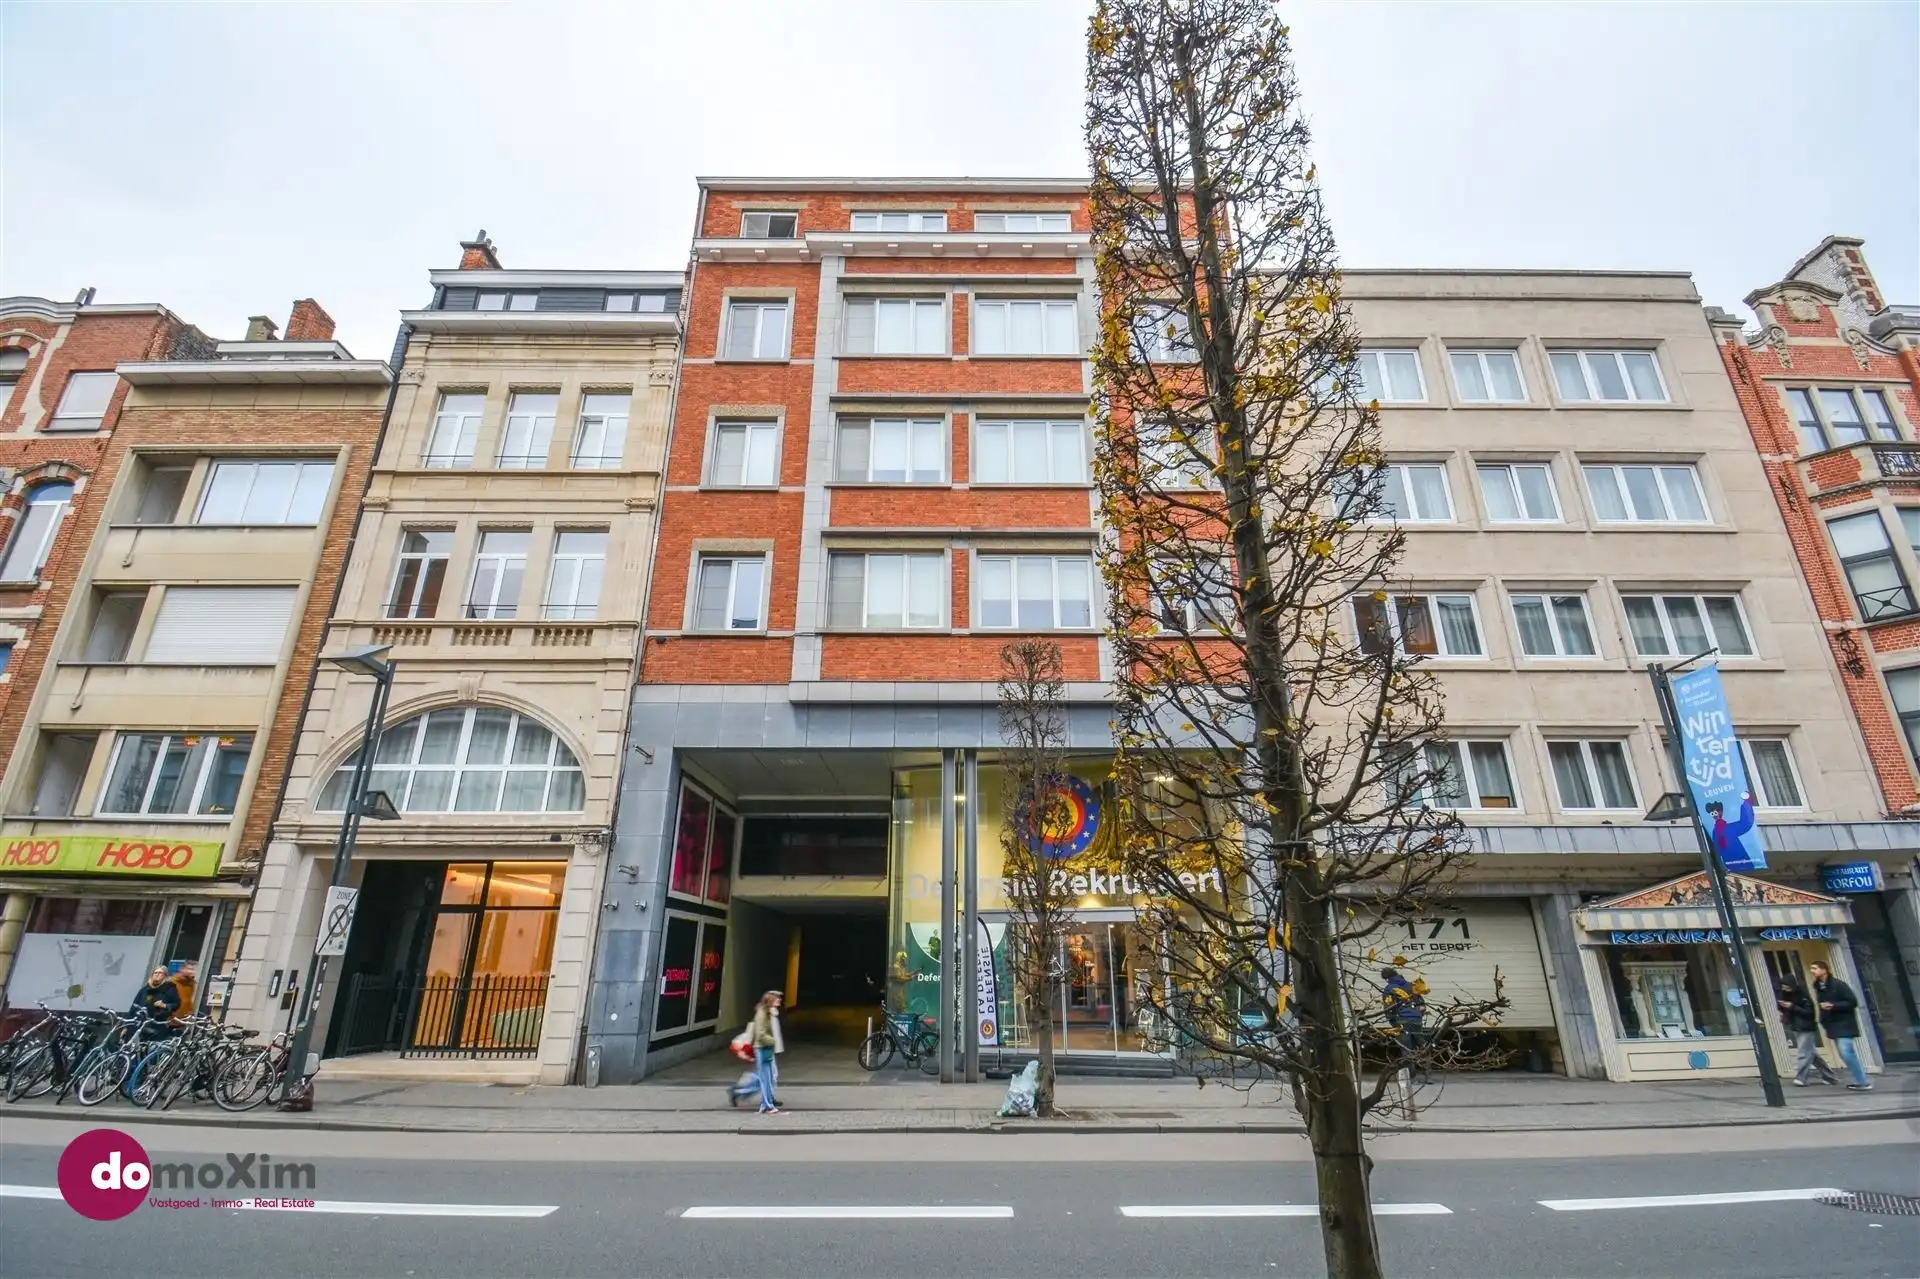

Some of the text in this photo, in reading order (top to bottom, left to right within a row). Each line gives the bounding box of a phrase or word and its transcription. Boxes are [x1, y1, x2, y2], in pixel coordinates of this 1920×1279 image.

[1680, 711, 1725, 739] Win
[1696, 735, 1736, 755] ter
[1687, 755, 1732, 786] tijd
[1704, 783, 1735, 797] LEUVEN
[1, 840, 60, 866] HOBO
[97, 842, 193, 870] HOBO
[1050, 868, 1222, 896] Rekruert
[1826, 876, 1873, 890] CORFOU
[336, 890, 353, 901] ZONE
[1399, 917, 1470, 939] 171
[1611, 928, 1724, 944] RESTAURA
[1430, 943, 1471, 951] DEPOT
